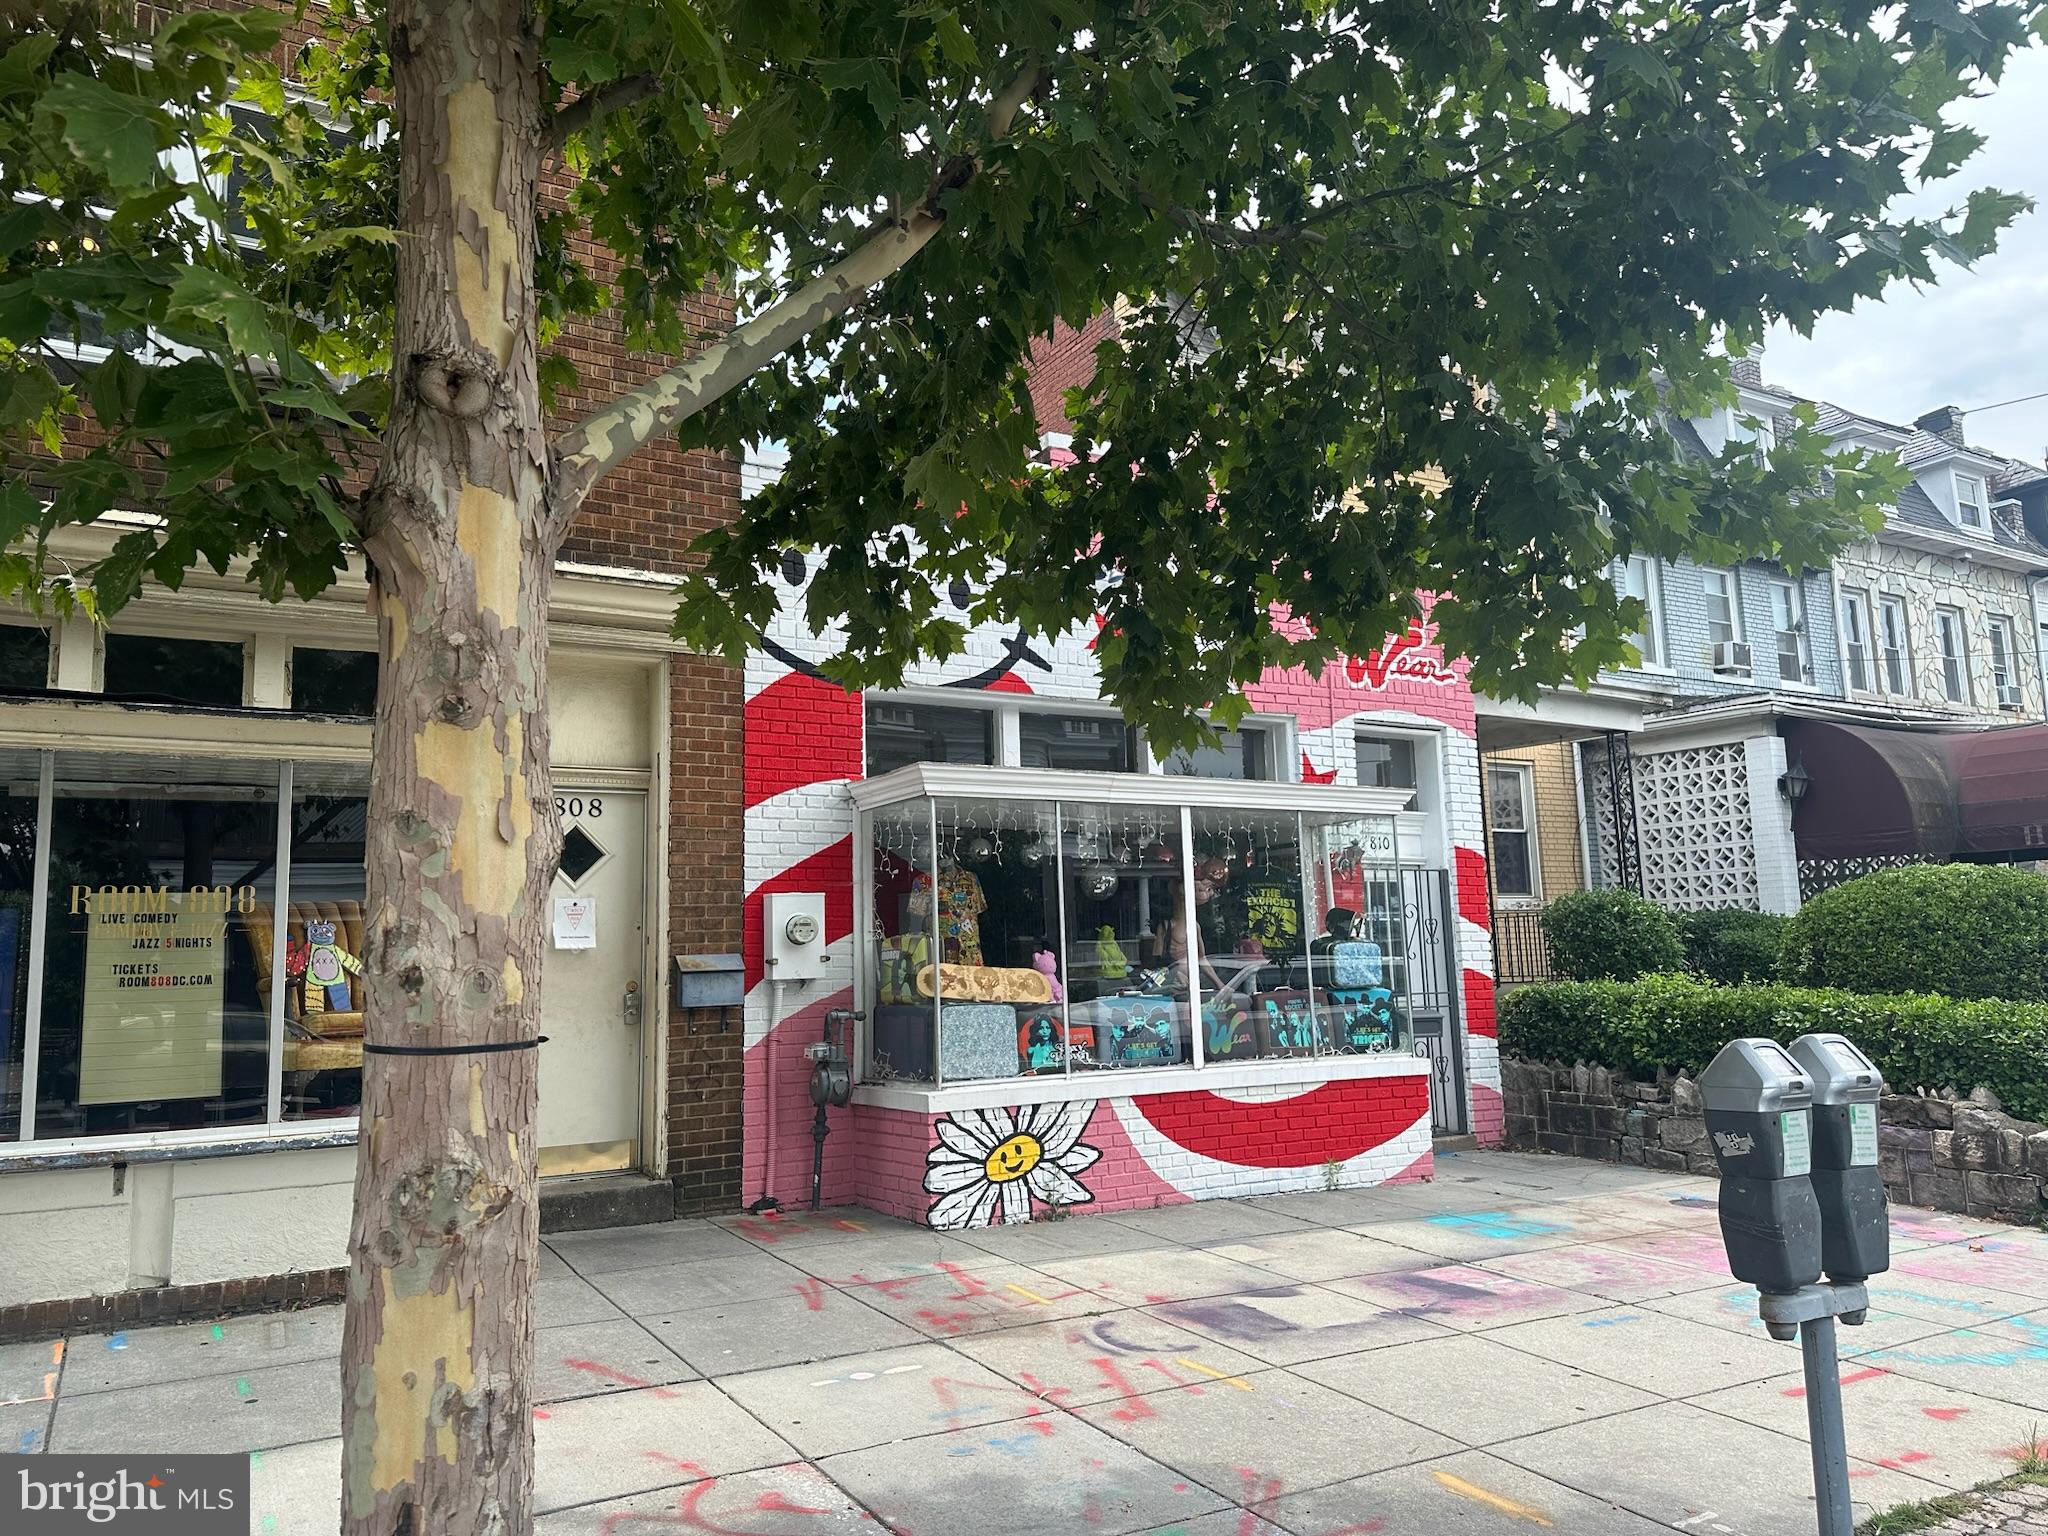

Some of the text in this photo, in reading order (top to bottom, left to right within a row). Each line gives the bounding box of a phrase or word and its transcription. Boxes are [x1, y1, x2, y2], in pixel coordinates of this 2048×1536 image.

[1343, 627, 1457, 691] Wear
[555, 797, 602, 818] 808
[1370, 836, 1390, 850] 810
[1260, 888, 1281, 898] THE
[68, 885, 170, 915] ROOM
[1247, 896, 1296, 908] EXORCIST
[101, 913, 178, 924] LIVE COMEDY
[132, 938, 160, 949] JAZZ
[175, 937, 213, 948] NIGHTS
[112, 963, 159, 975] TICKETS
[118, 975, 213, 988] ROOM808DC.COM
